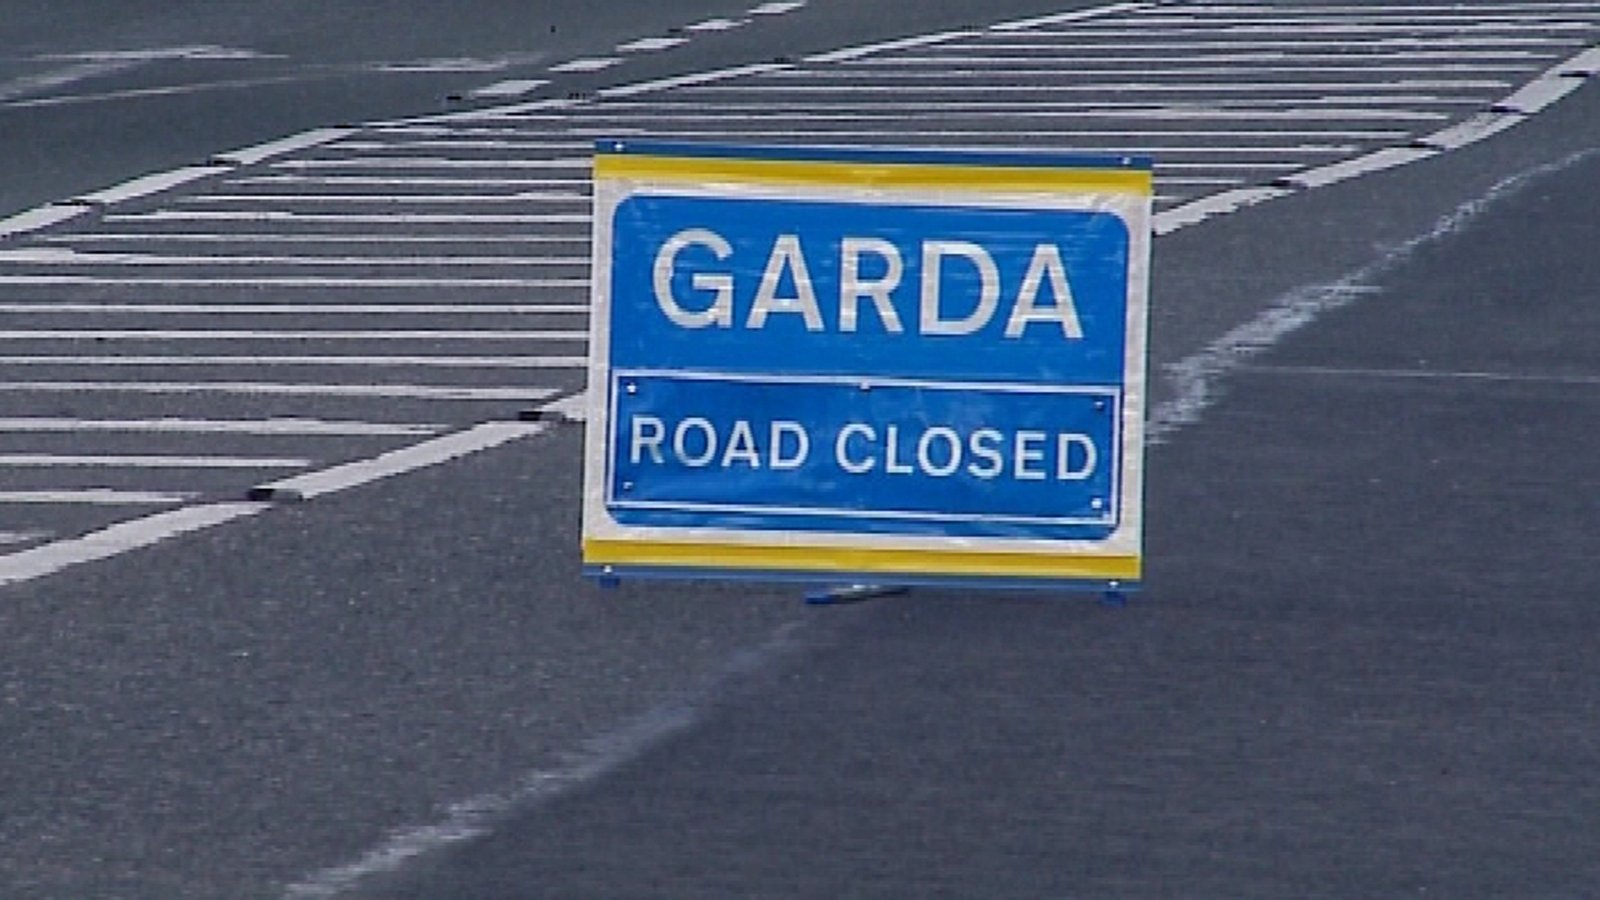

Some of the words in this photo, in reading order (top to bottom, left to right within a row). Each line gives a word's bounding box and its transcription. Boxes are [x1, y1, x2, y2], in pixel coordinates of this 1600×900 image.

[652, 228, 1084, 339] GARDA
[630, 416, 810, 470] ROAD
[835, 423, 1098, 480] CLOSED
